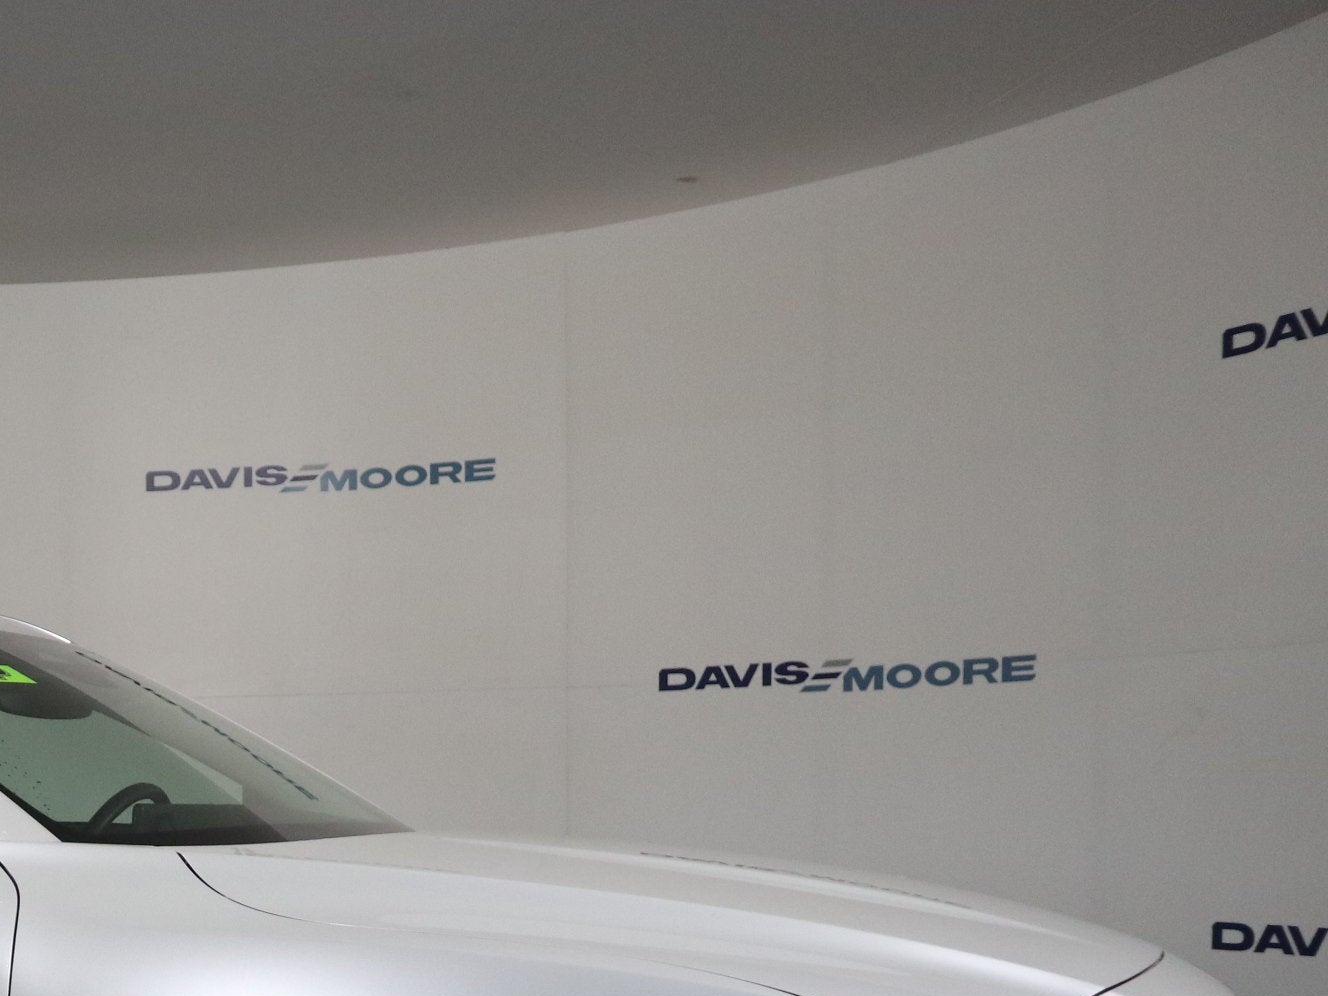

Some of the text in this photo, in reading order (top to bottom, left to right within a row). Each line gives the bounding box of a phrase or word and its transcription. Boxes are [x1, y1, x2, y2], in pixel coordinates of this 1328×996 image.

[146, 458, 496, 492] DAVIS MOORE
[658, 654, 1036, 692] DAVIS MOORE
